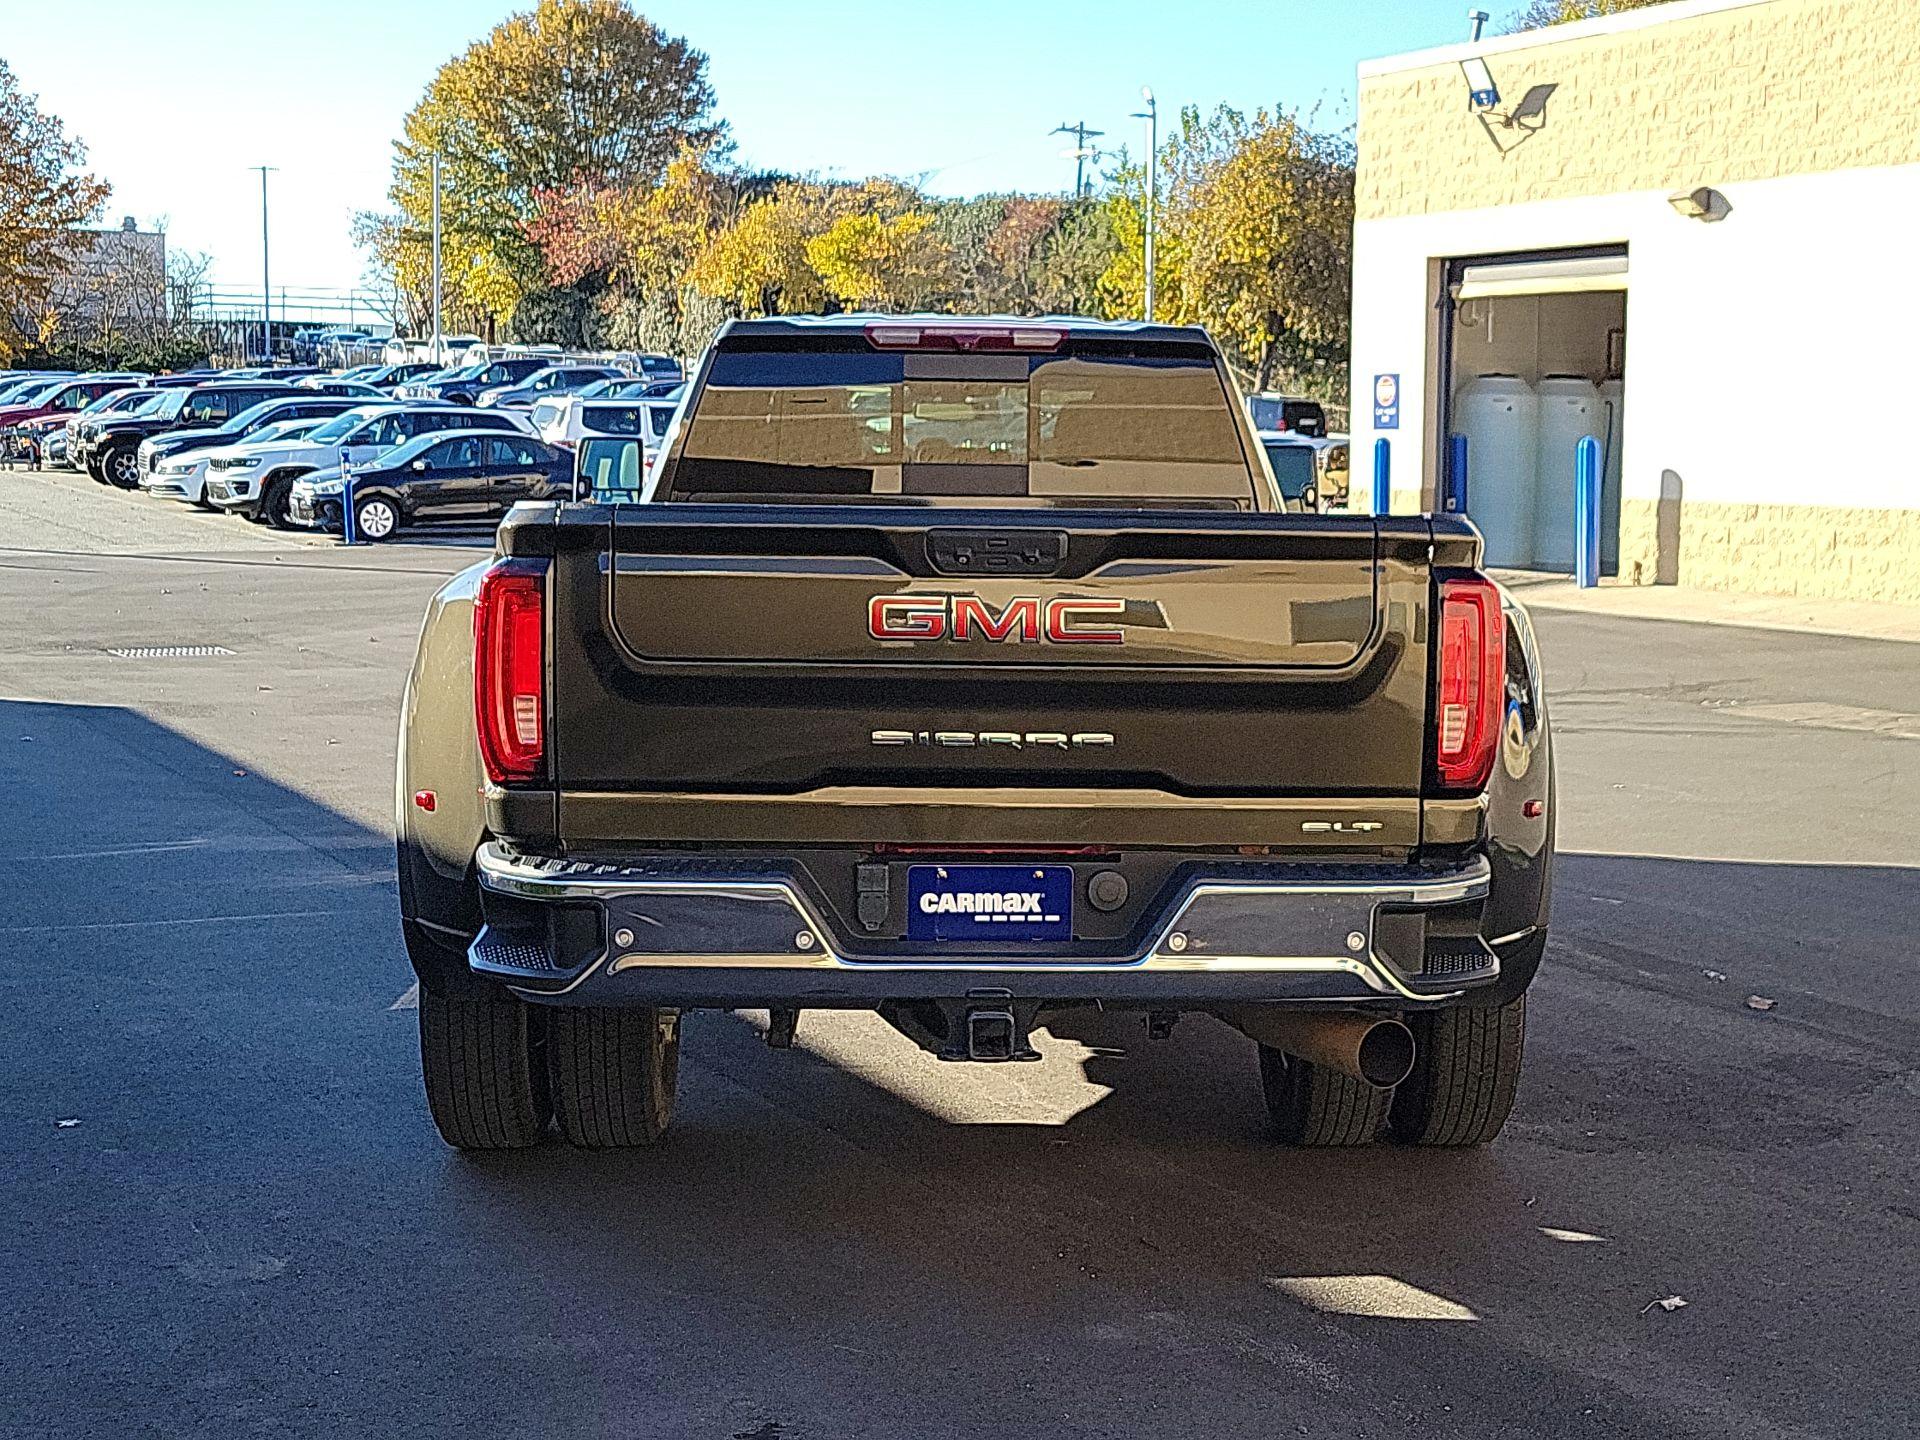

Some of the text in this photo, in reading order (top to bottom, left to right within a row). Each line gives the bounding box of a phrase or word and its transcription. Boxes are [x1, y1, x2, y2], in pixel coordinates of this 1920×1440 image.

[868, 595, 1125, 643] GMC
[871, 731, 1115, 750] SIERRA
[1301, 822, 1383, 832] SLT
